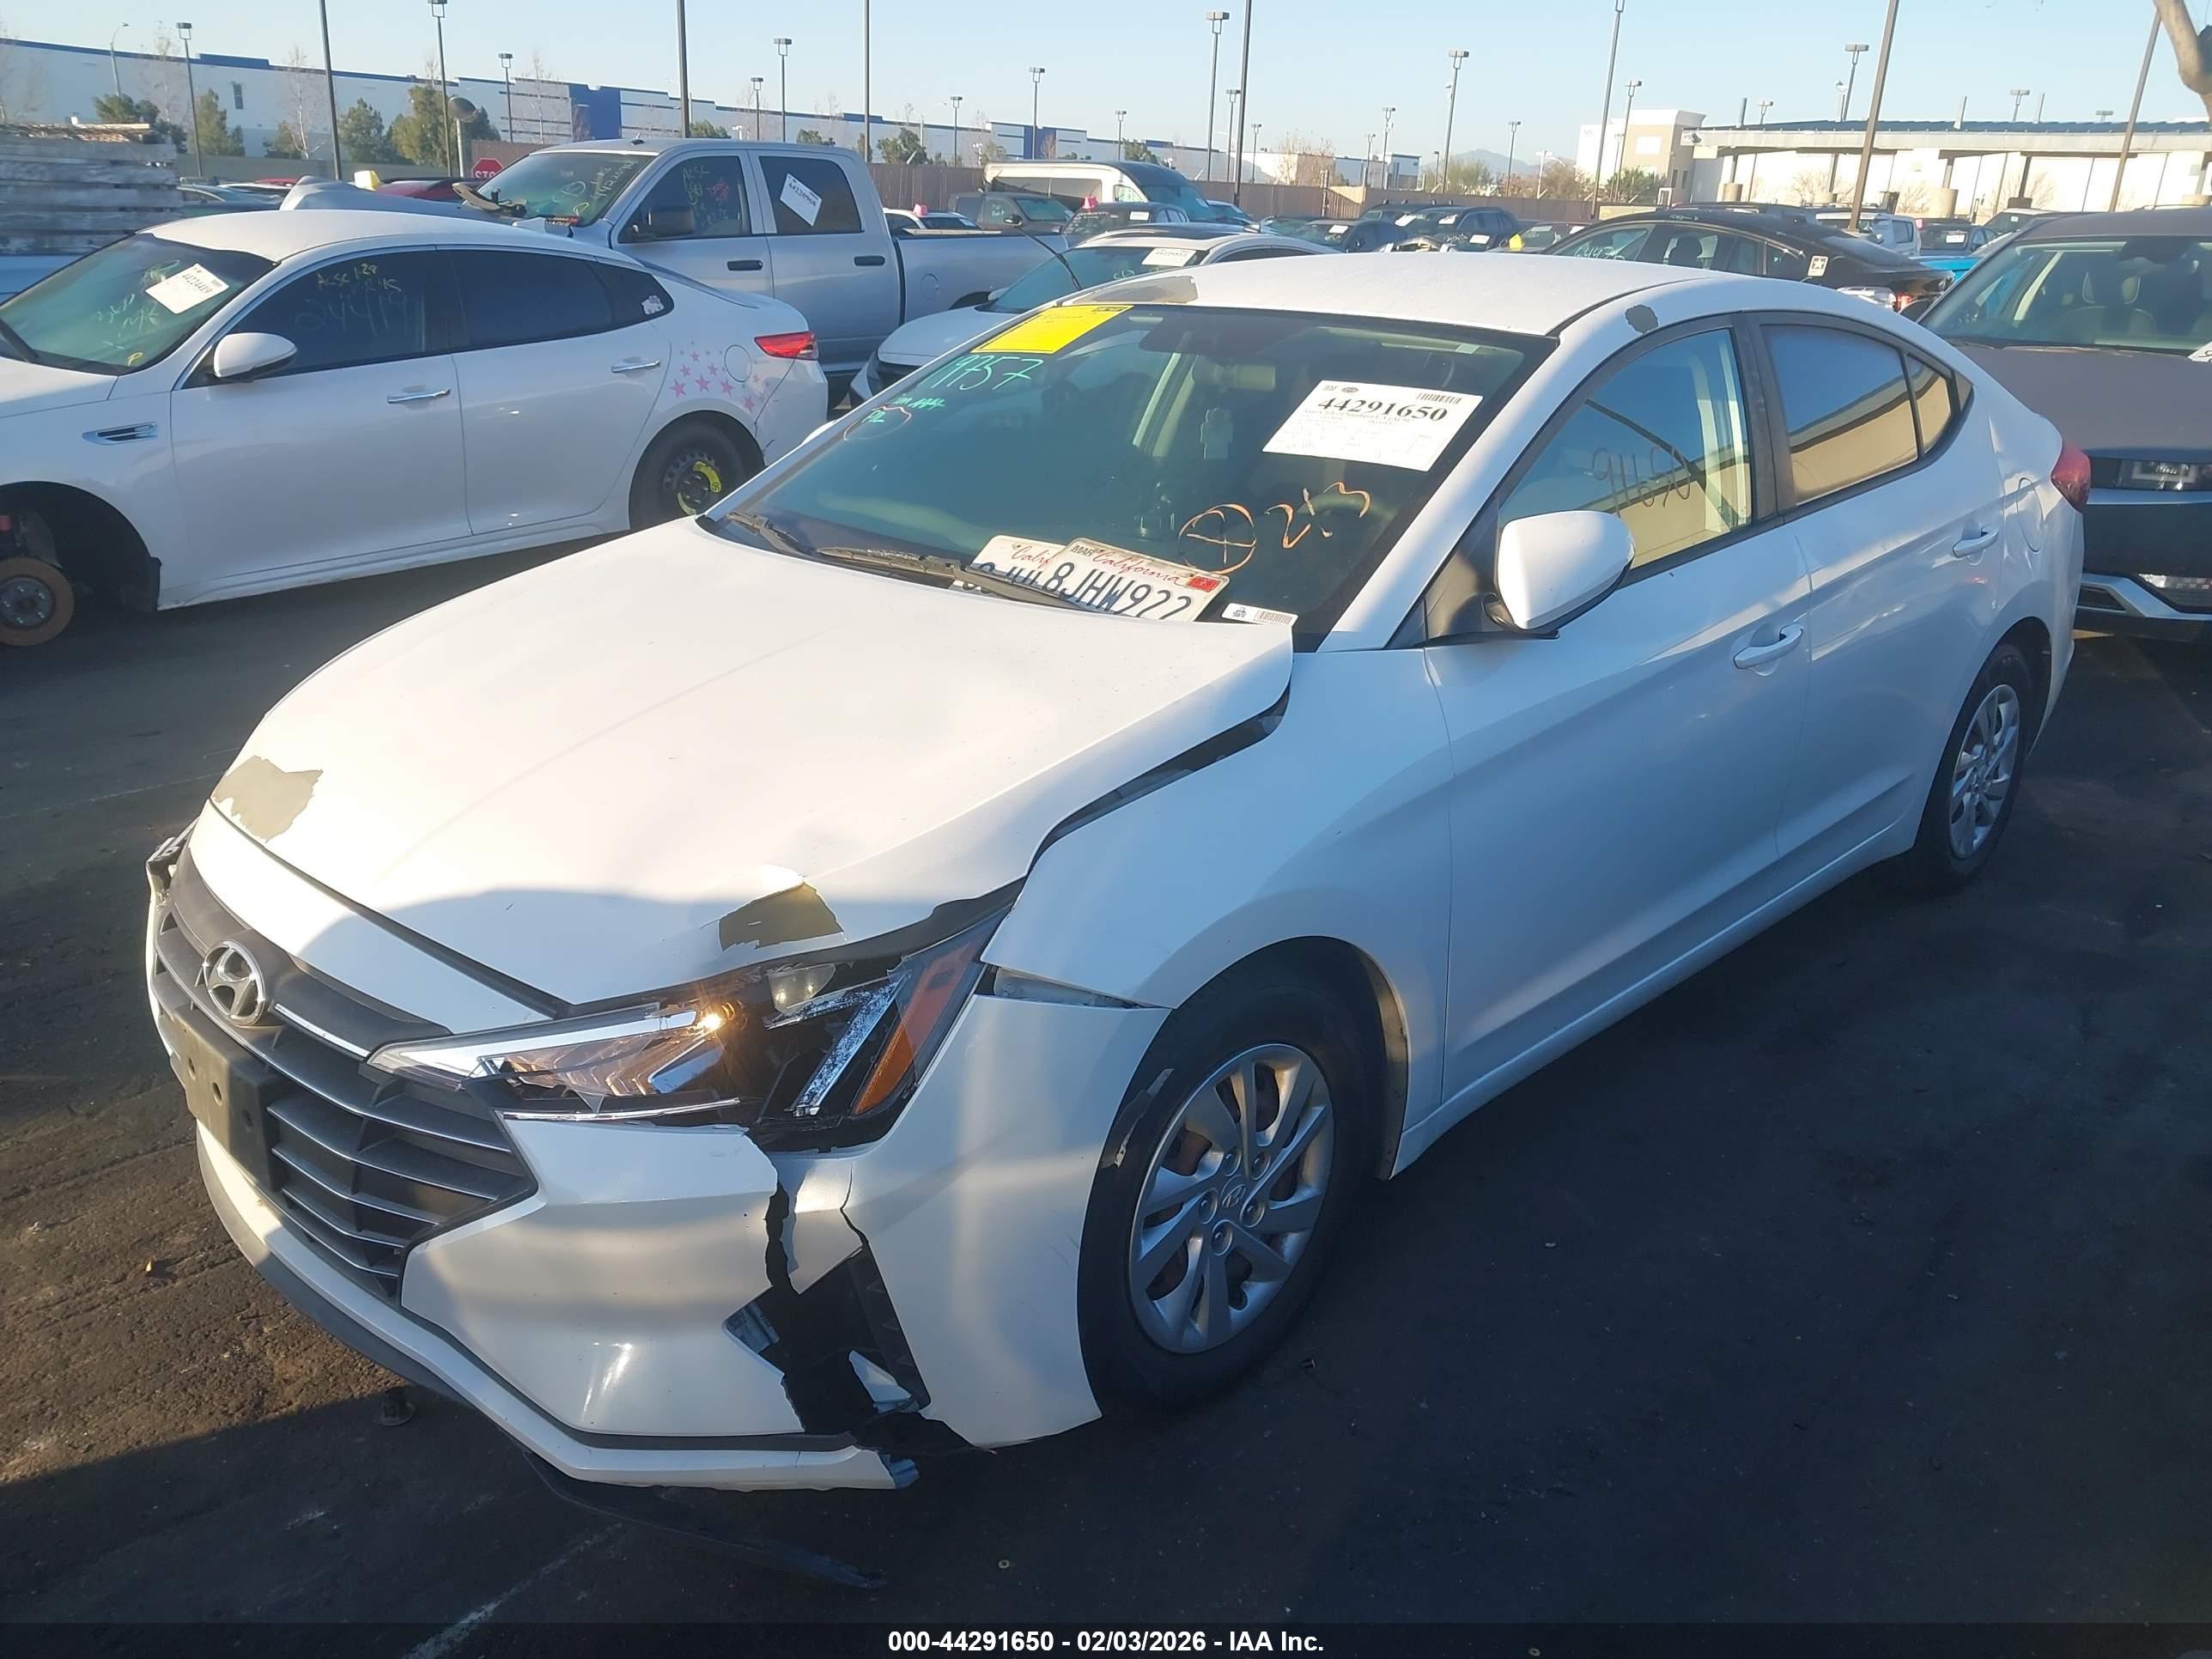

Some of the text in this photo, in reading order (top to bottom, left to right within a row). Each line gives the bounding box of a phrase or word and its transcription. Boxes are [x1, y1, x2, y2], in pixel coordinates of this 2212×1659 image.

[1317, 397, 1449, 422] 44291650
[1092, 550, 1188, 587] California
[1044, 561, 1193, 621] 8JHW922
